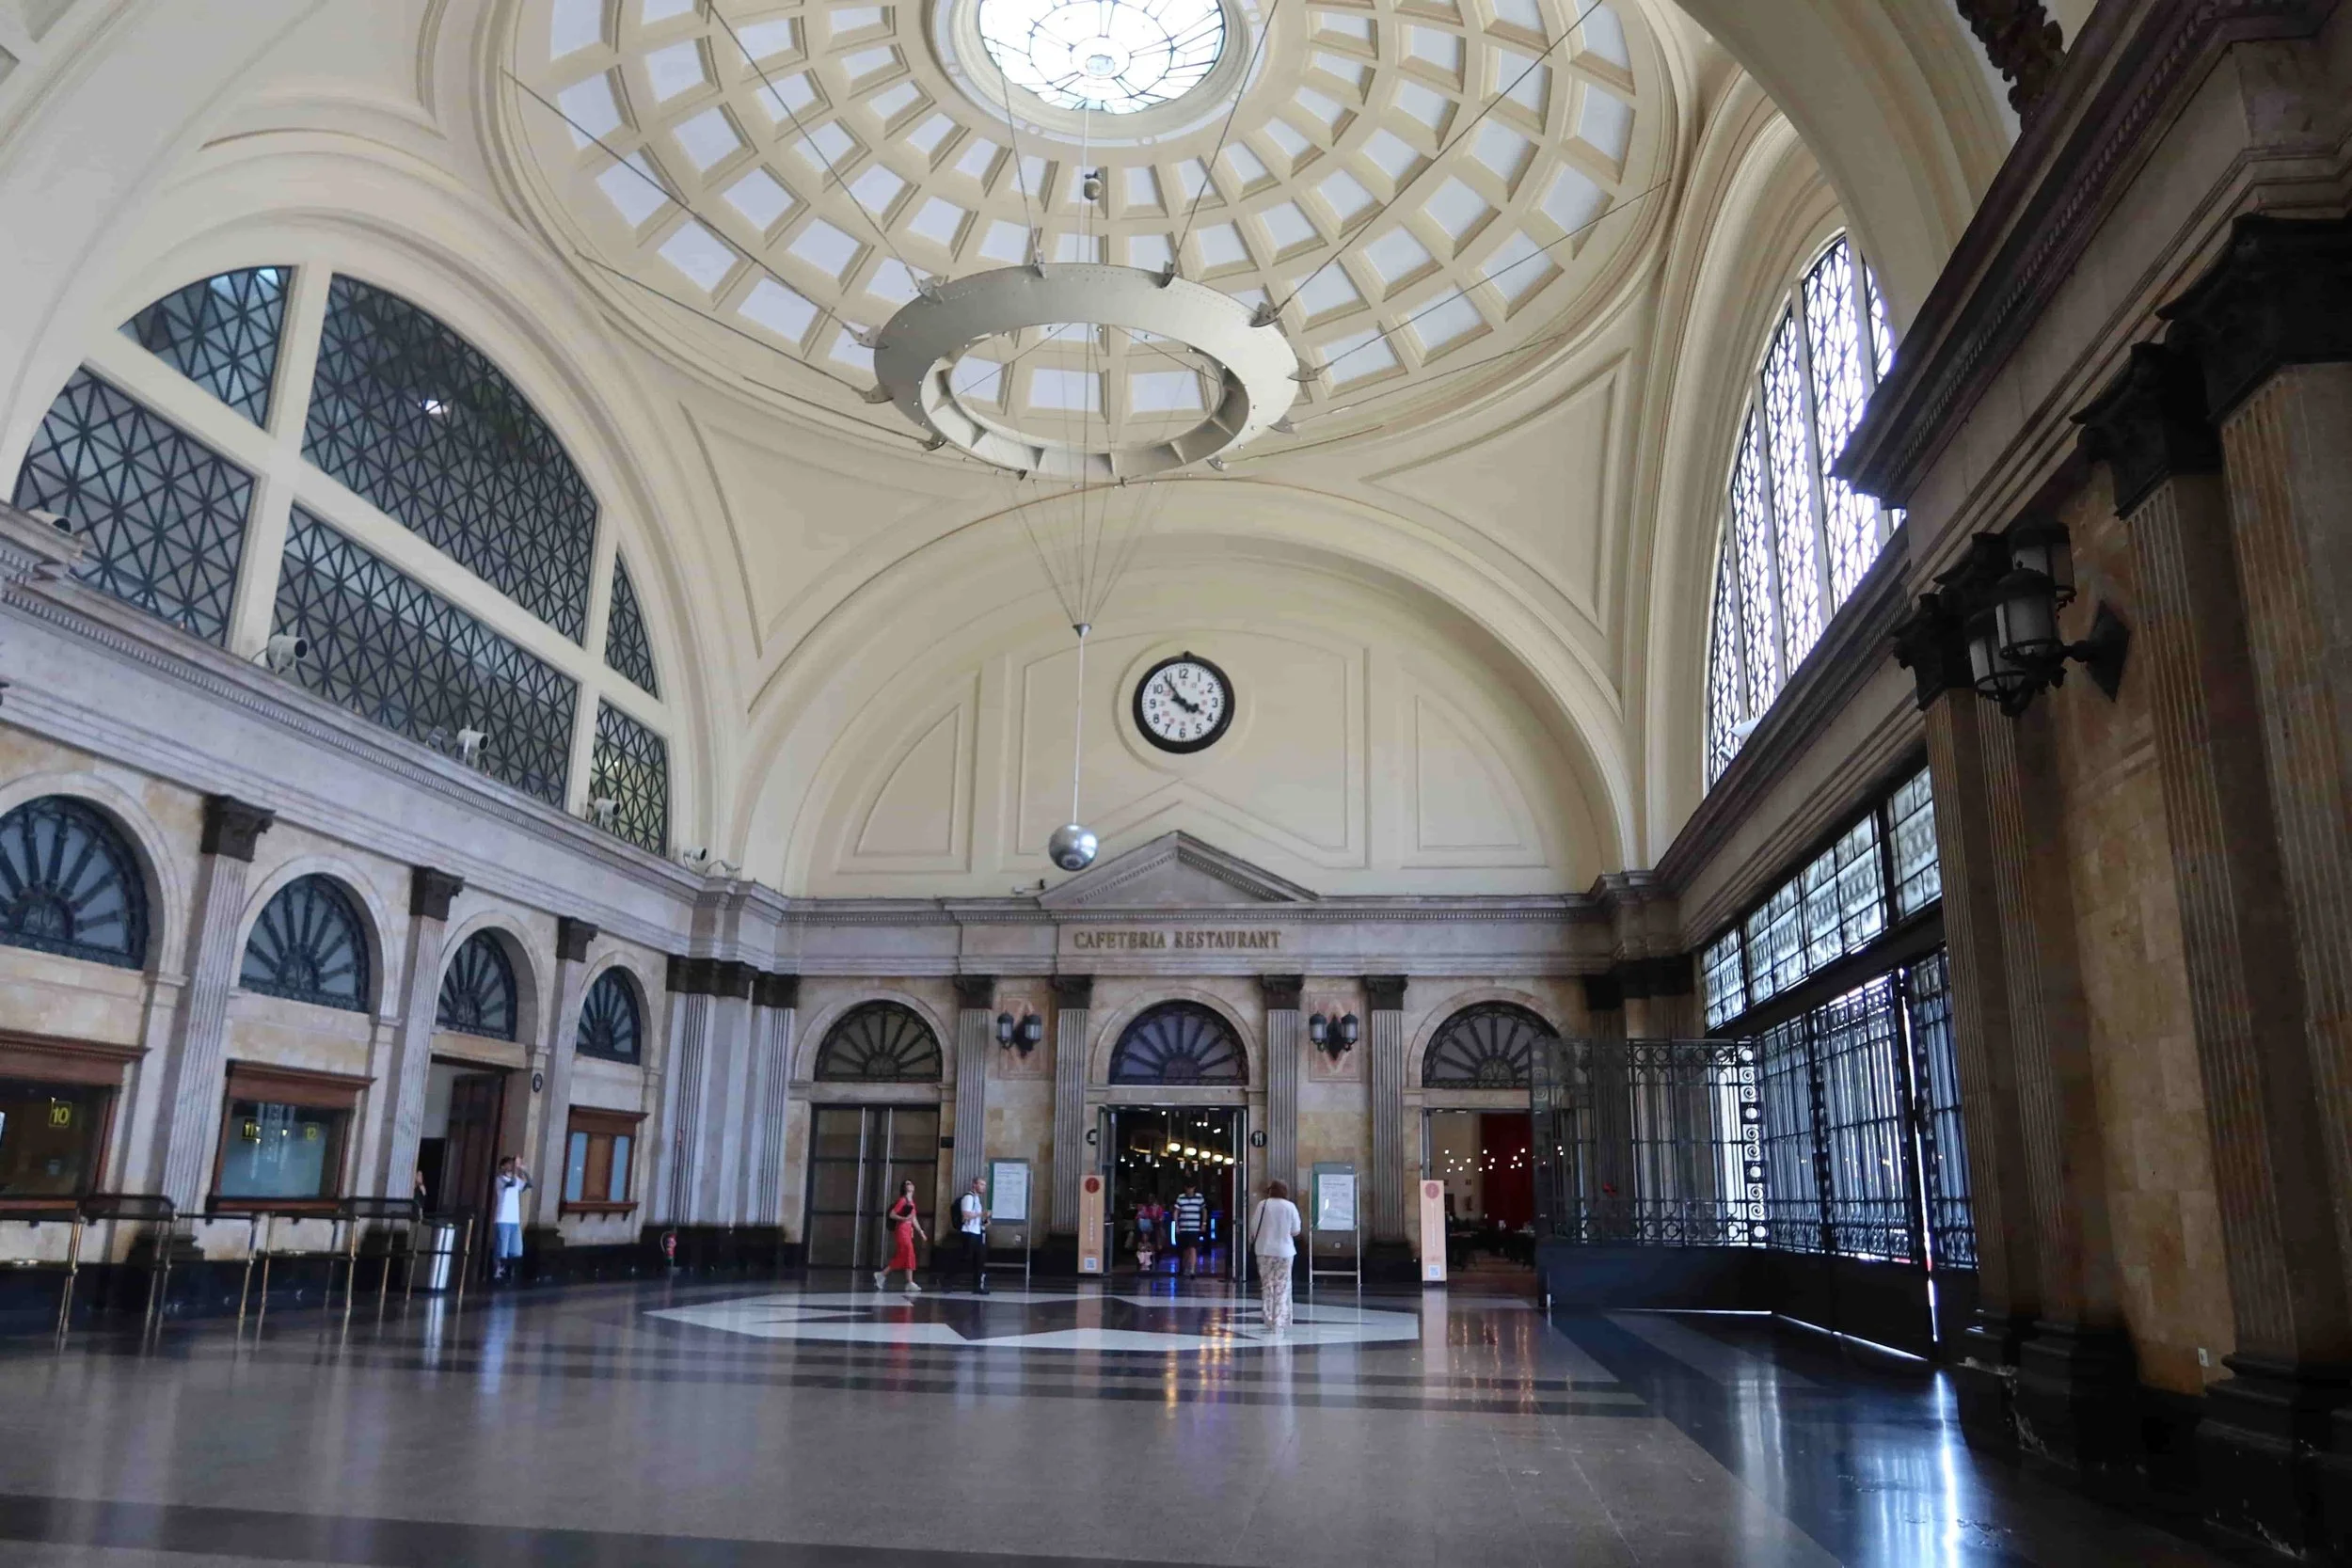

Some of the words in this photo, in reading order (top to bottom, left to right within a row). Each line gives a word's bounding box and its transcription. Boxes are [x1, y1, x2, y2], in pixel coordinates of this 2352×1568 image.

[1179, 668, 1189, 679] 12
[1198, 672, 1201, 683] 1
[1153, 684, 1163, 694] 10
[1207, 682, 1214, 693] 2
[1150, 698, 1156, 709] 9
[1212, 697, 1218, 708] 3
[1152, 713, 1159, 724] 8
[1206, 712, 1214, 722] 4
[1164, 722, 1171, 735] 7
[1179, 727, 1186, 738] 6
[1195, 722, 1202, 734] 5
[1073, 930, 1167, 949] CAFETERIA
[1174, 930, 1281, 949] RESTAURANT
[53, 1106, 69, 1124] 10
